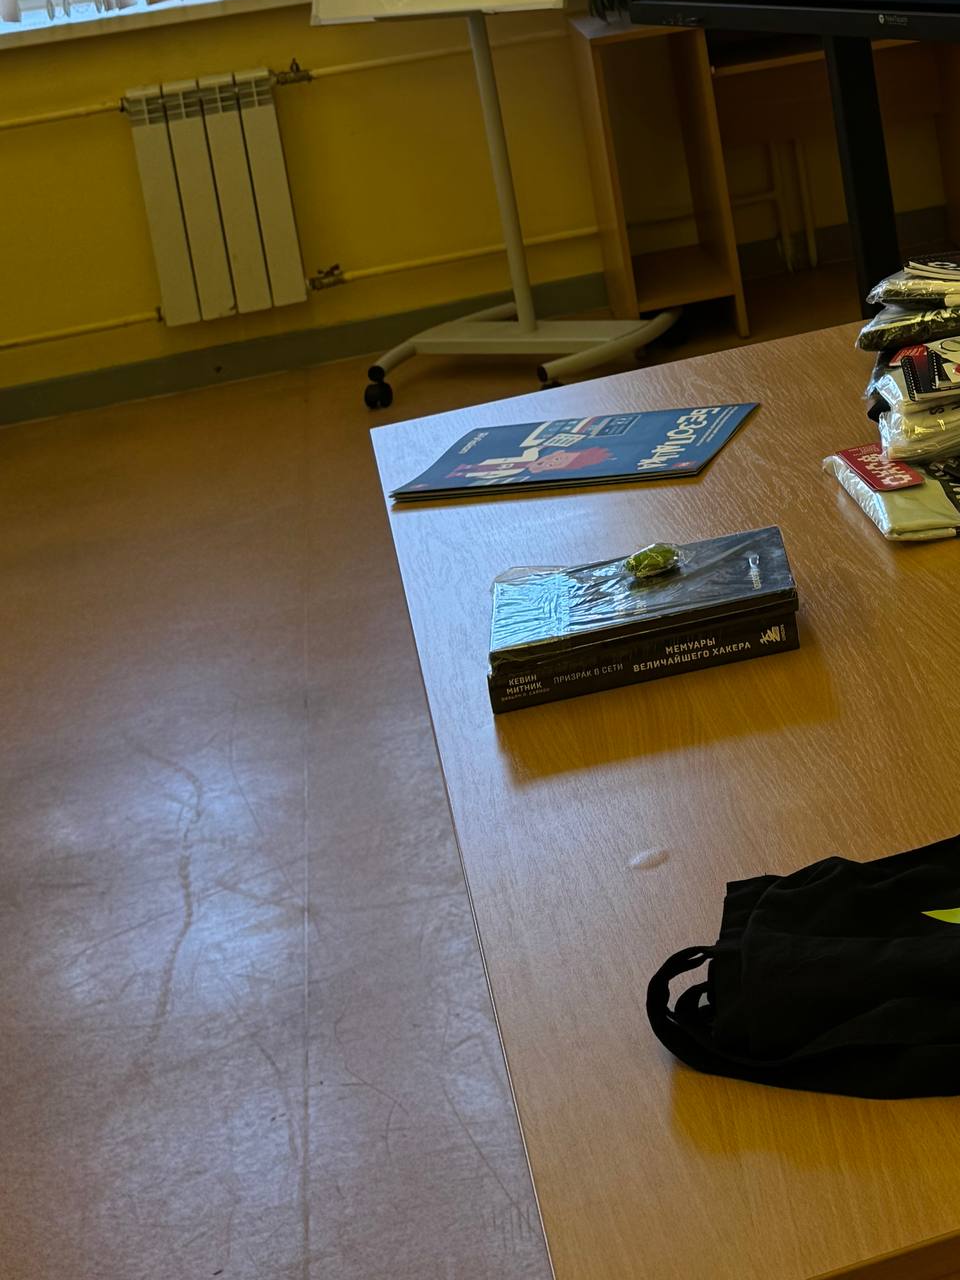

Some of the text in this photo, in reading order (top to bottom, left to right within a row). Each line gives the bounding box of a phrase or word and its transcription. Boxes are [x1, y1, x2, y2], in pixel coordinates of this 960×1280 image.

[665, 637, 716, 655] МЕМУАРЫ
[633, 641, 751, 672] ВЕЛИЧАЙШЕГО ХАКЕРА
[508, 674, 537, 686] КЕВИН
[553, 670, 592, 684] ПРИЗРАК
[602, 663, 624, 674] СЕТИ
[506, 681, 542, 695] МИТНИК
